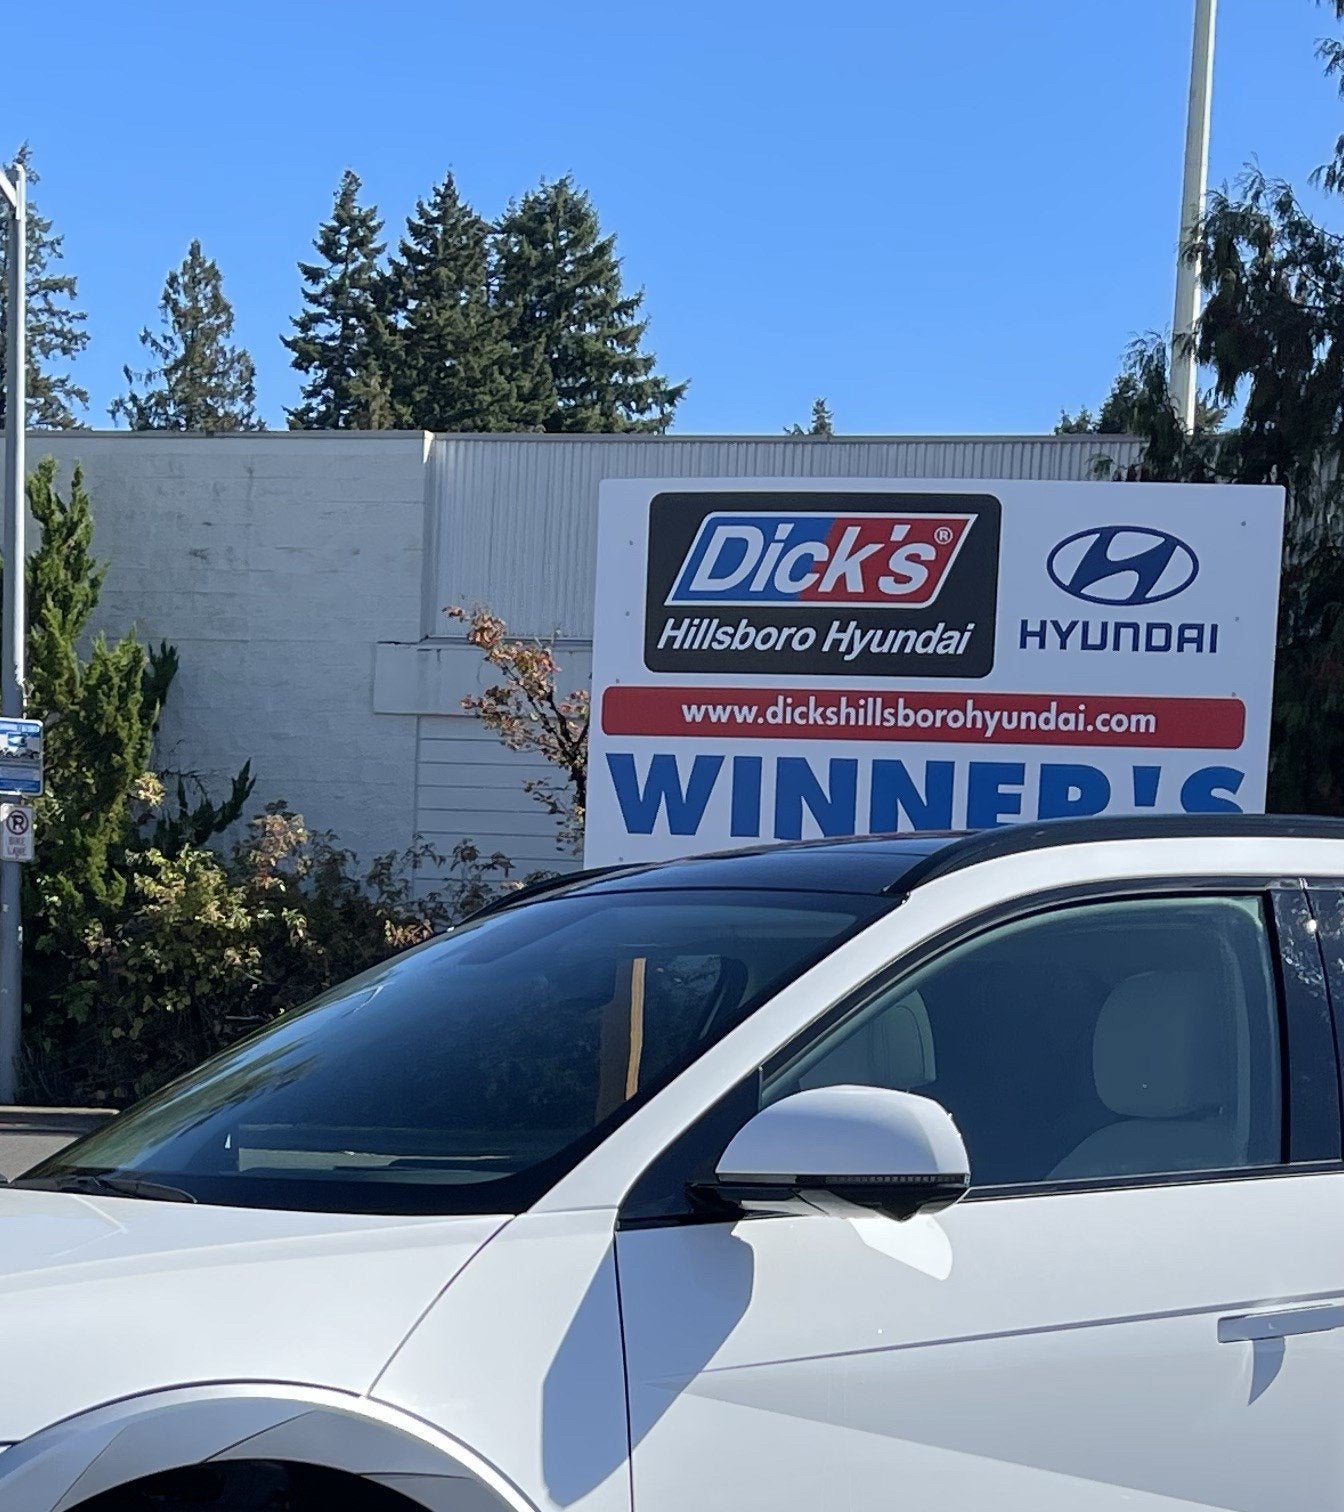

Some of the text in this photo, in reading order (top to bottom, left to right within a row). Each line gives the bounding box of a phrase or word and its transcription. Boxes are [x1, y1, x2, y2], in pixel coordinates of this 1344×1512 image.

[656, 617, 976, 662] Hillsboro Hyundai
[1019, 618, 1218, 655] HYUNDAI
[681, 695, 1157, 736] www.dickshillsborohyundai.com
